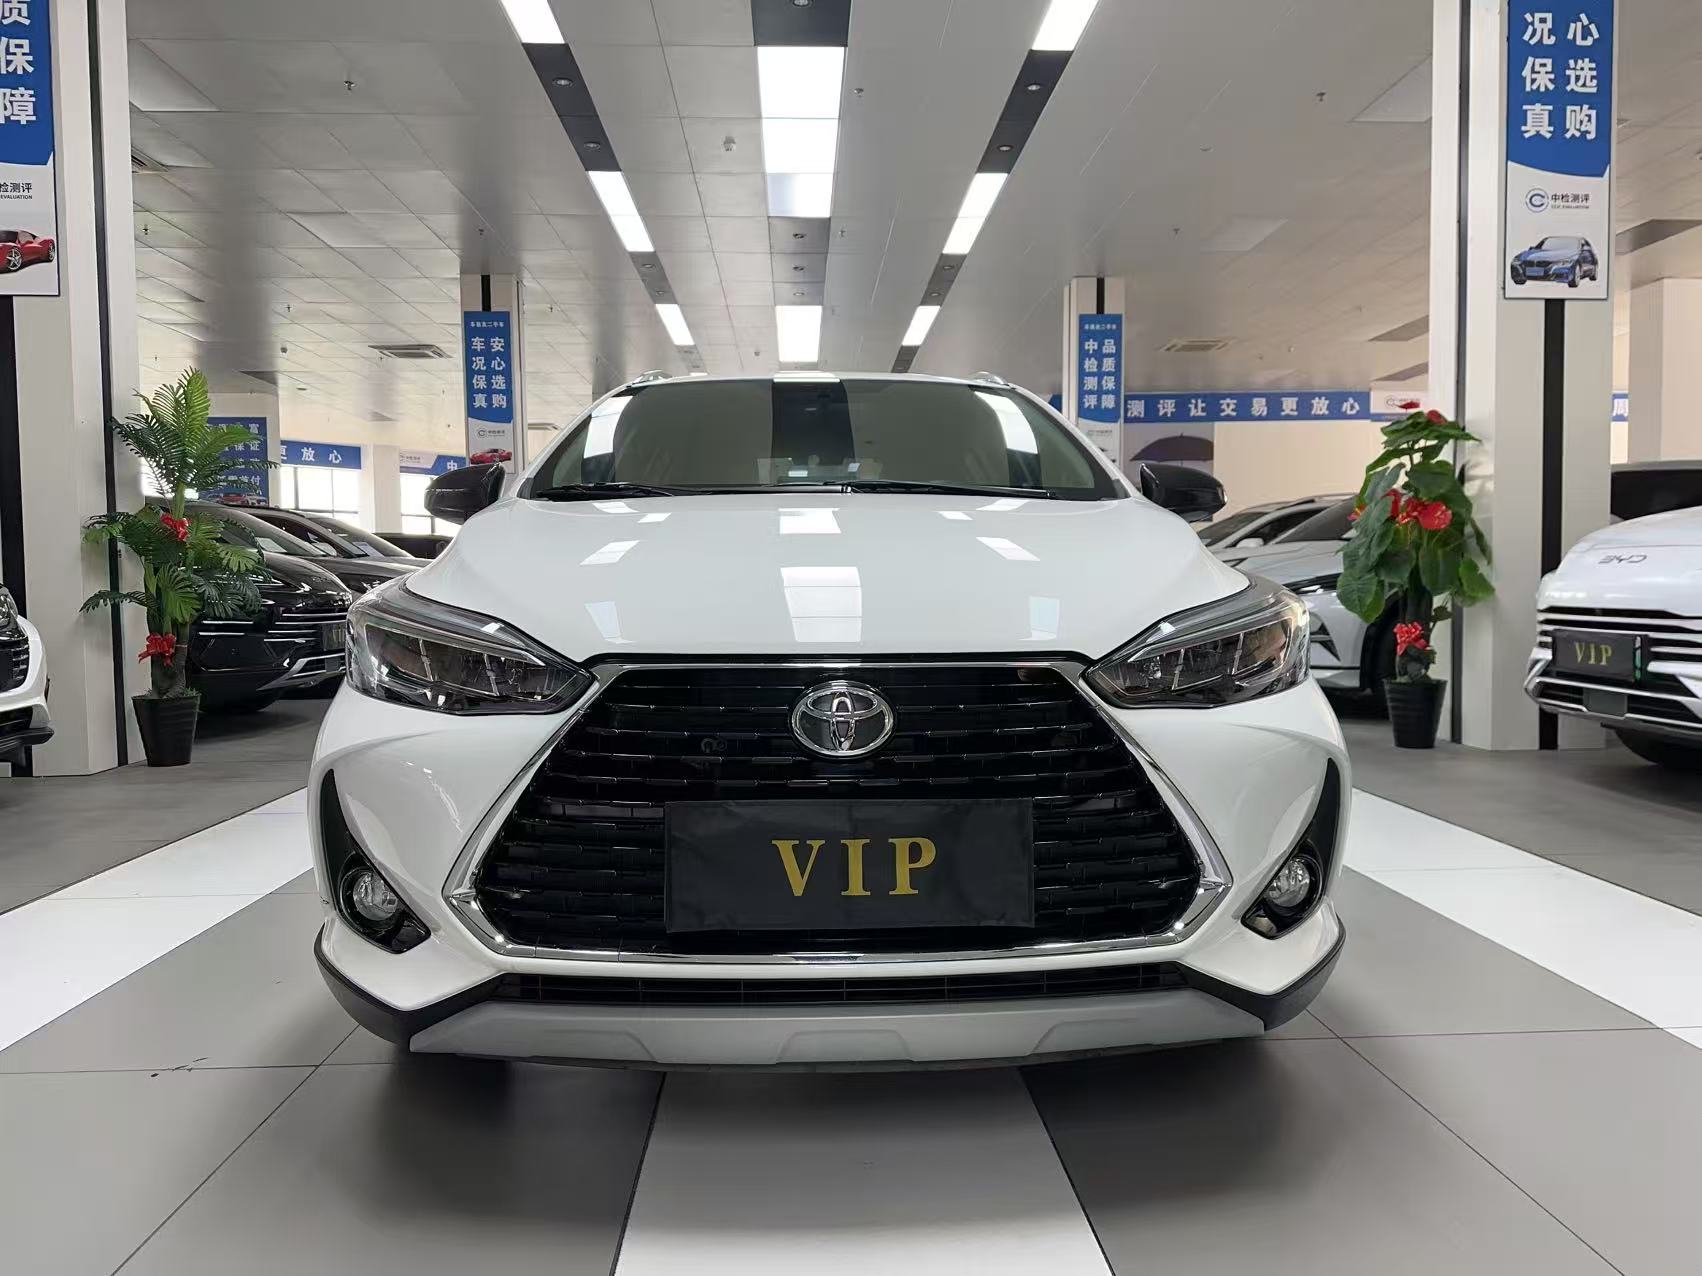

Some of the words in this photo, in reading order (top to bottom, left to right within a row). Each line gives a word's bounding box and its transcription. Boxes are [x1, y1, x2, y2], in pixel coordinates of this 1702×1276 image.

[1521, 12, 1556, 140] 况保真
[1565, 13, 1600, 141] 心选购
[1551, 193, 1590, 204] 中检测评
[471, 337, 488, 409] 车况保真
[490, 337, 507, 409] 安心选购
[1083, 339, 1098, 409] 中检测评
[1102, 339, 1116, 409] 品质保障
[1127, 396, 1360, 418] 测评让交易更放心
[1574, 642, 1612, 665] VIP
[771, 837, 937, 896] VIP
